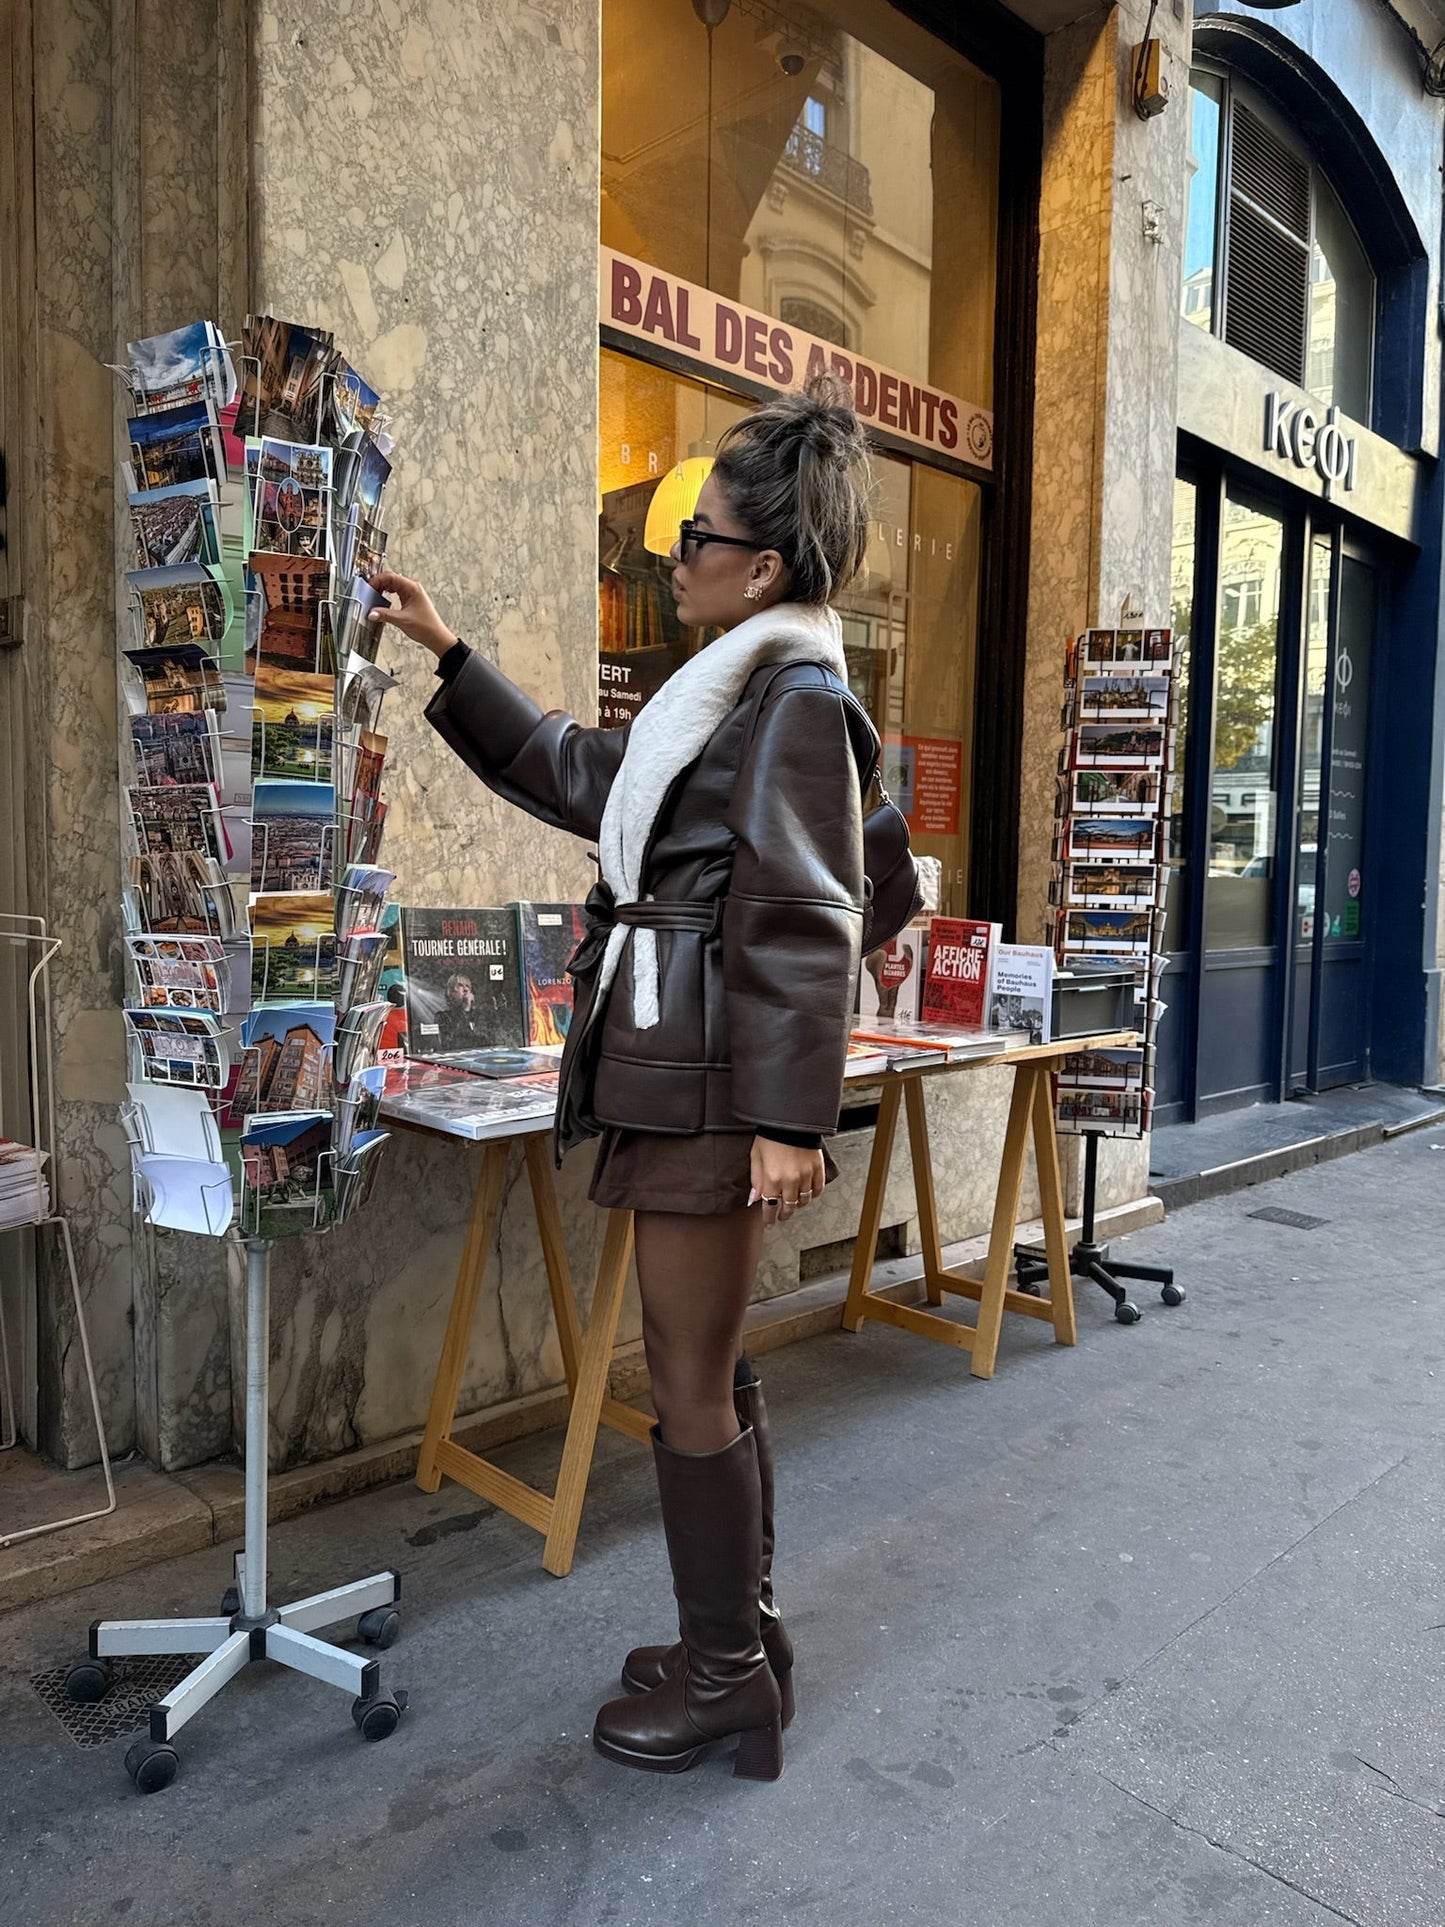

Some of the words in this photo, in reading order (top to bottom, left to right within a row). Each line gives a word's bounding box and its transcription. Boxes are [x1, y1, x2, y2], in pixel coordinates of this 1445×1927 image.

[611, 258, 701, 352] BAL
[715, 302, 793, 385] DES
[803, 343, 958, 449] ARDENTS
[599, 663, 631, 683] ERT
[610, 688, 642, 701] Samedi
[604, 705, 610, 717] à
[613, 707, 632, 720] 19h
[441, 919, 477, 937] RENAUD
[412, 938, 454, 957] TOURNÉE
[457, 938, 501, 956] GÉNÉRALE
[1012, 950, 1044, 958] Bauhaus
[932, 958, 980, 980] ACTION
[998, 971, 1032, 980] Memories
[997, 985, 1021, 993] People
[1006, 979, 1037, 987] Bauhaus
